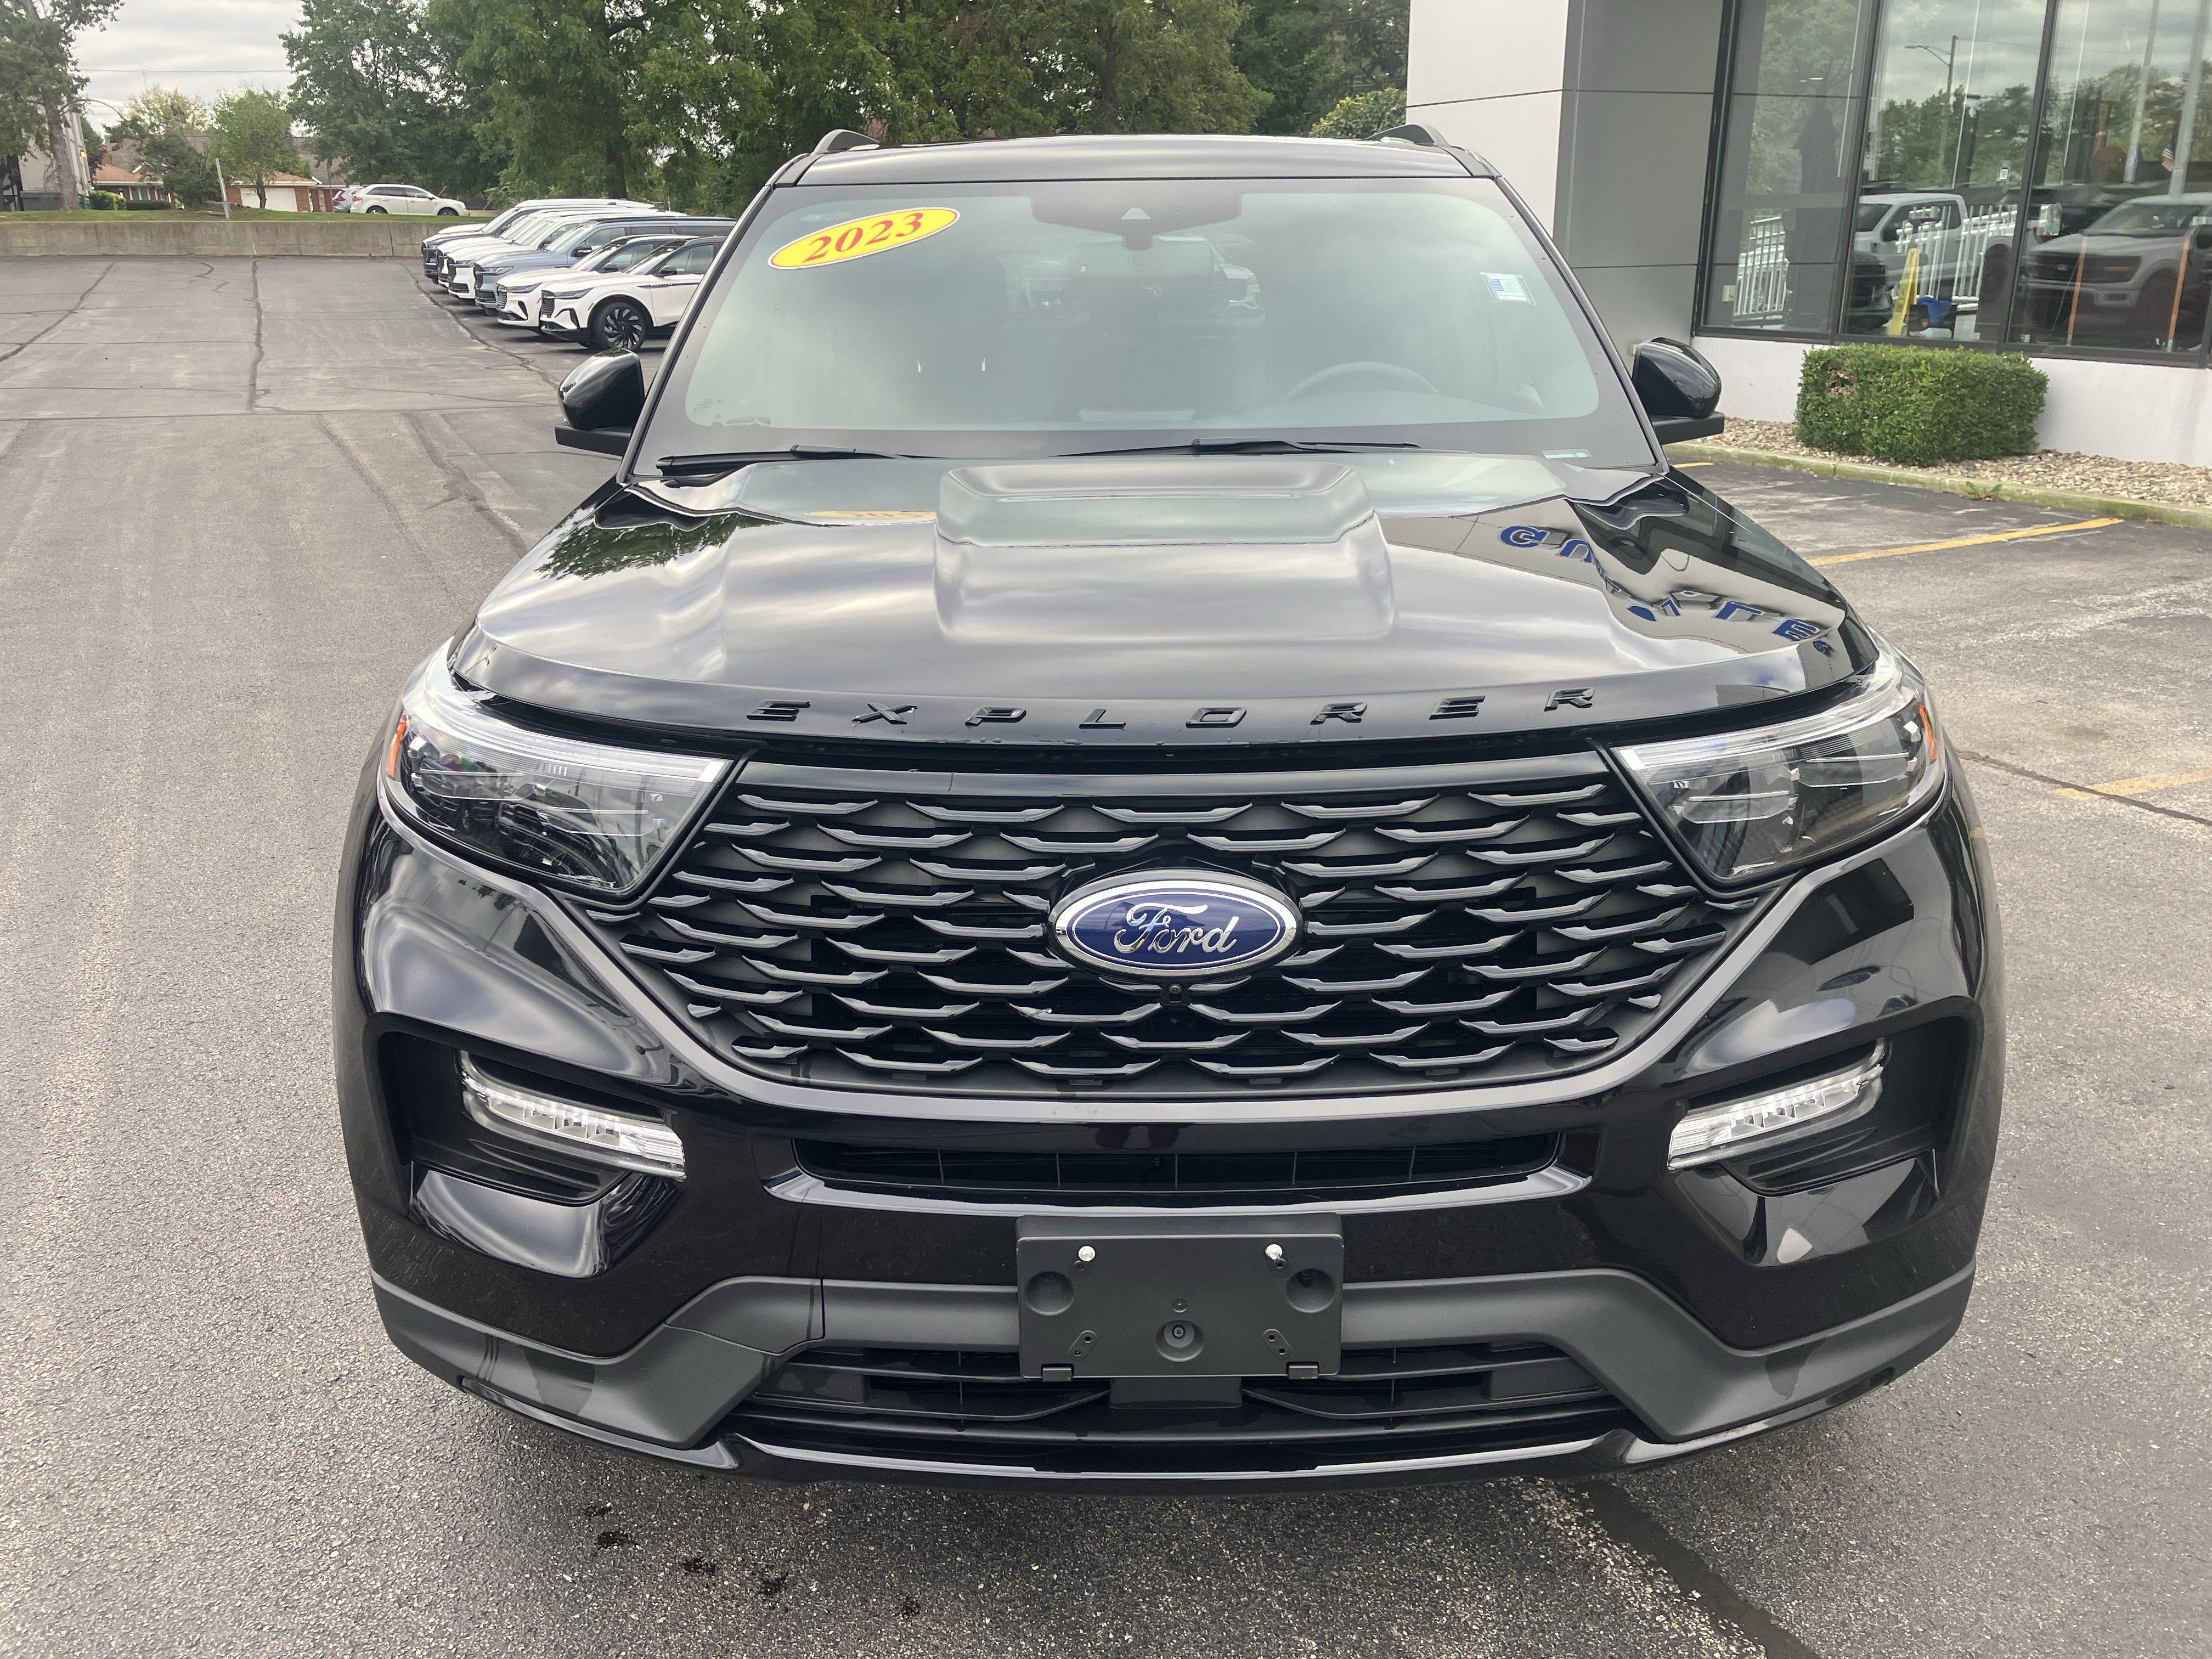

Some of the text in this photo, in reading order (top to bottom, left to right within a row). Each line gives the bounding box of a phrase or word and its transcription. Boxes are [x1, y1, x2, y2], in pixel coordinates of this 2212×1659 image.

[802, 212, 924, 263] 2023
[746, 686, 1596, 730] EXPLORER
[1113, 902, 1238, 955] Ford
